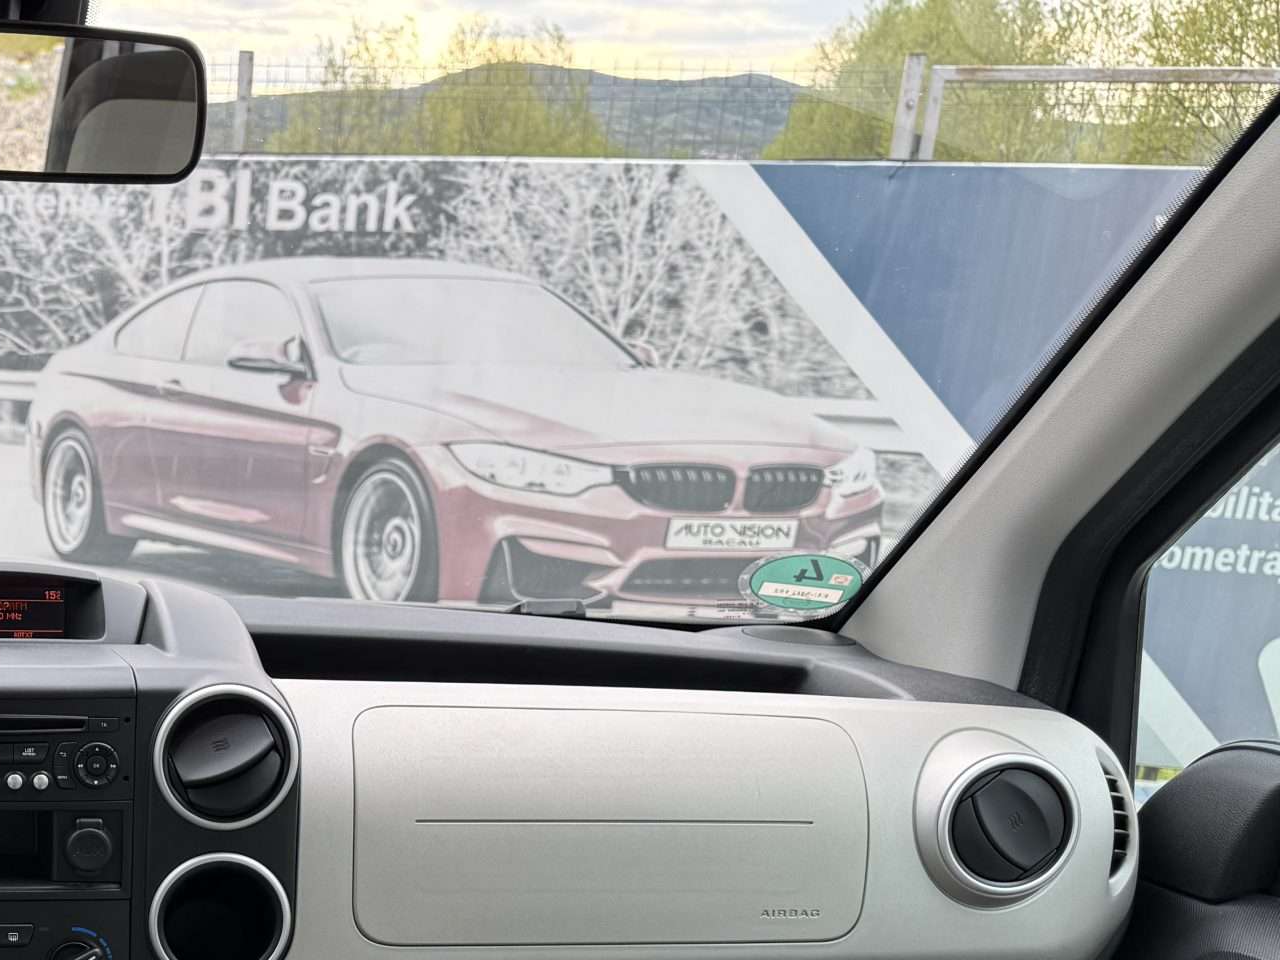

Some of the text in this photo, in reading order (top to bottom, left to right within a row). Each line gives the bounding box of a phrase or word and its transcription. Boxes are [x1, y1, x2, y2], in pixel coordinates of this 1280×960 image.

[265, 180, 419, 232] Bank
[674, 522, 793, 540] AUTO VISION
[760, 908, 821, 918] AIRBAG
